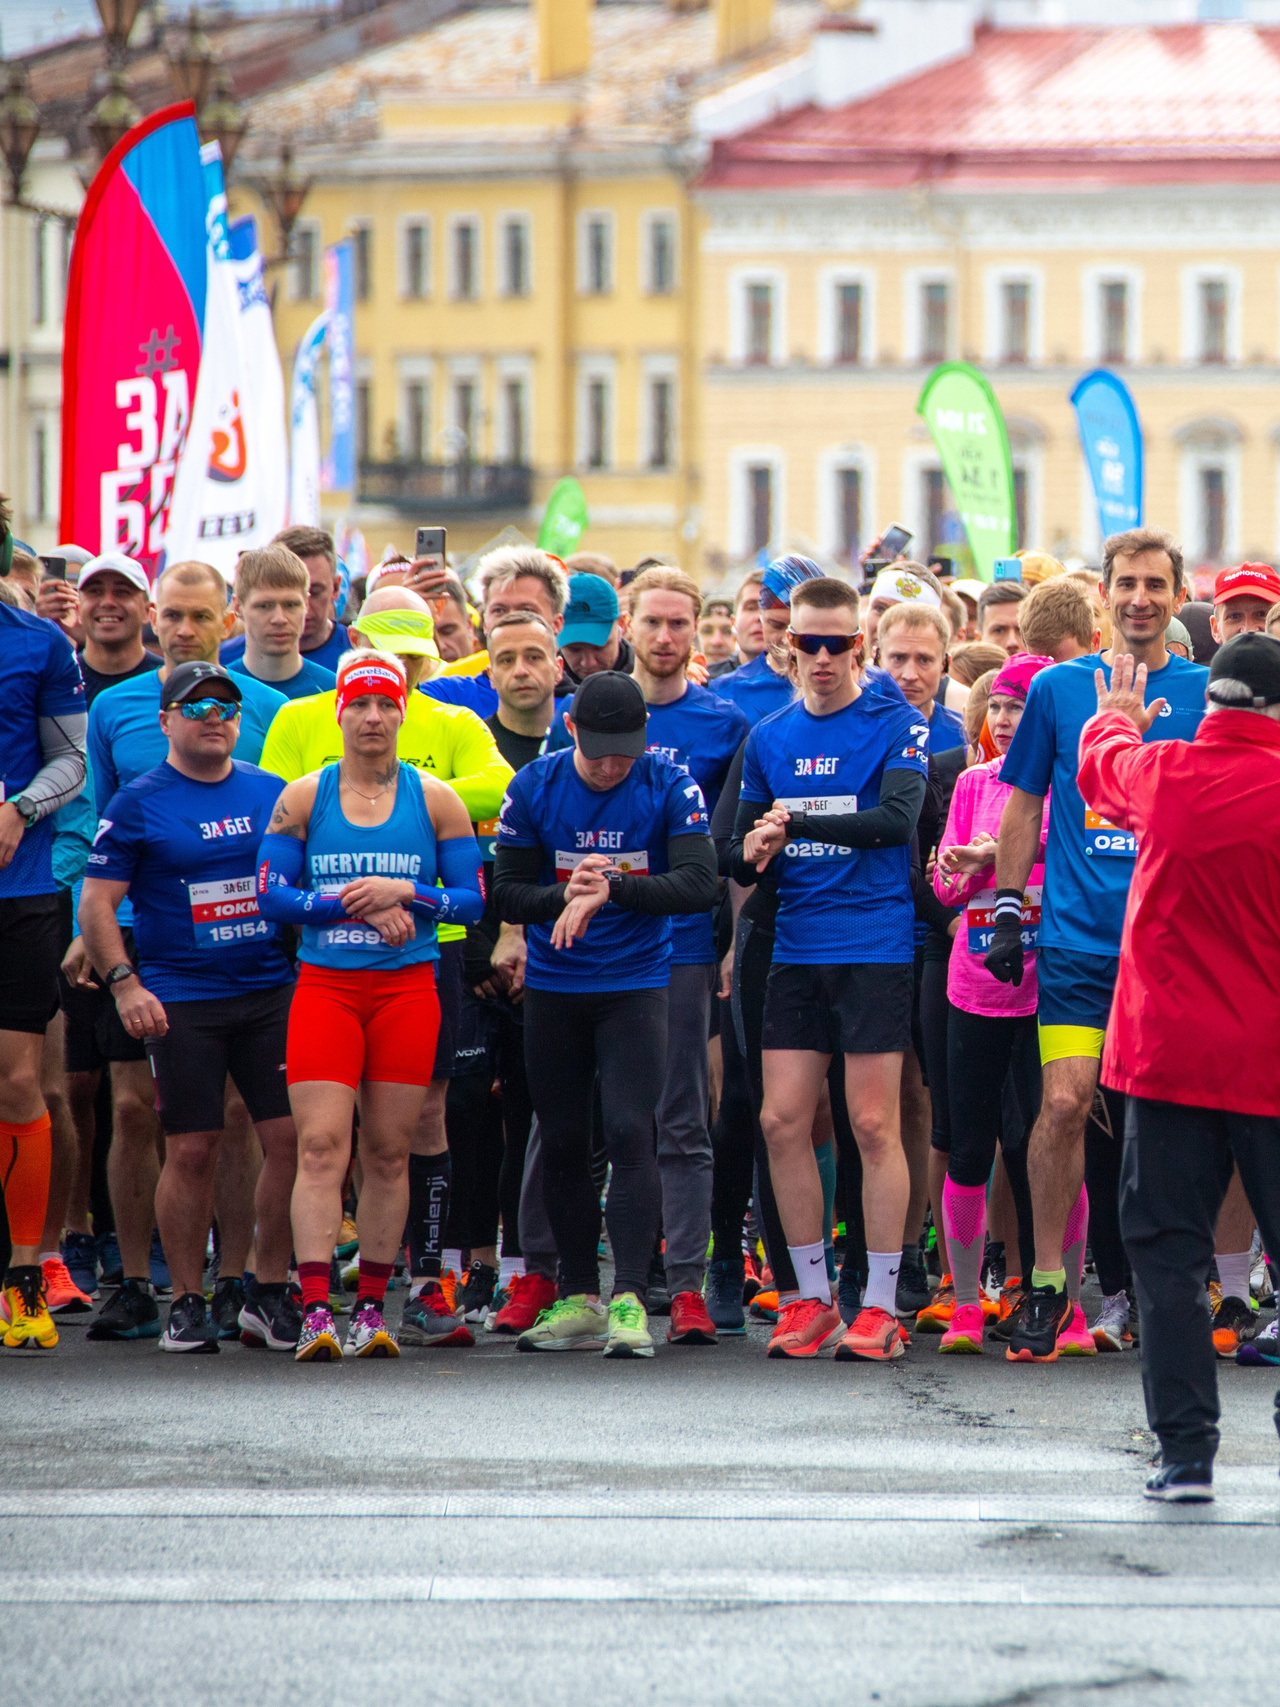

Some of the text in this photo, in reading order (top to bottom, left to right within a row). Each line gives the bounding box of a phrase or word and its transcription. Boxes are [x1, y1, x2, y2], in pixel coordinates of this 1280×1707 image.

[909, 724, 930, 748] 7
[795, 757, 840, 776] ЗА БЕГ
[683, 784, 706, 808] 7
[802, 800, 829, 812] ЗА БЕГ
[94, 818, 114, 847] 7
[200, 816, 253, 839] ЗА БЕГ
[575, 830, 624, 849] ЗА БЕГ
[1094, 835, 1139, 852] 021
[310, 852, 422, 876] EVERYTHING
[222, 880, 251, 895] ЗА БЕГ
[213, 900, 260, 917] 10КМ
[209, 920, 269, 942] 15154
[326, 929, 407, 945] 1269
